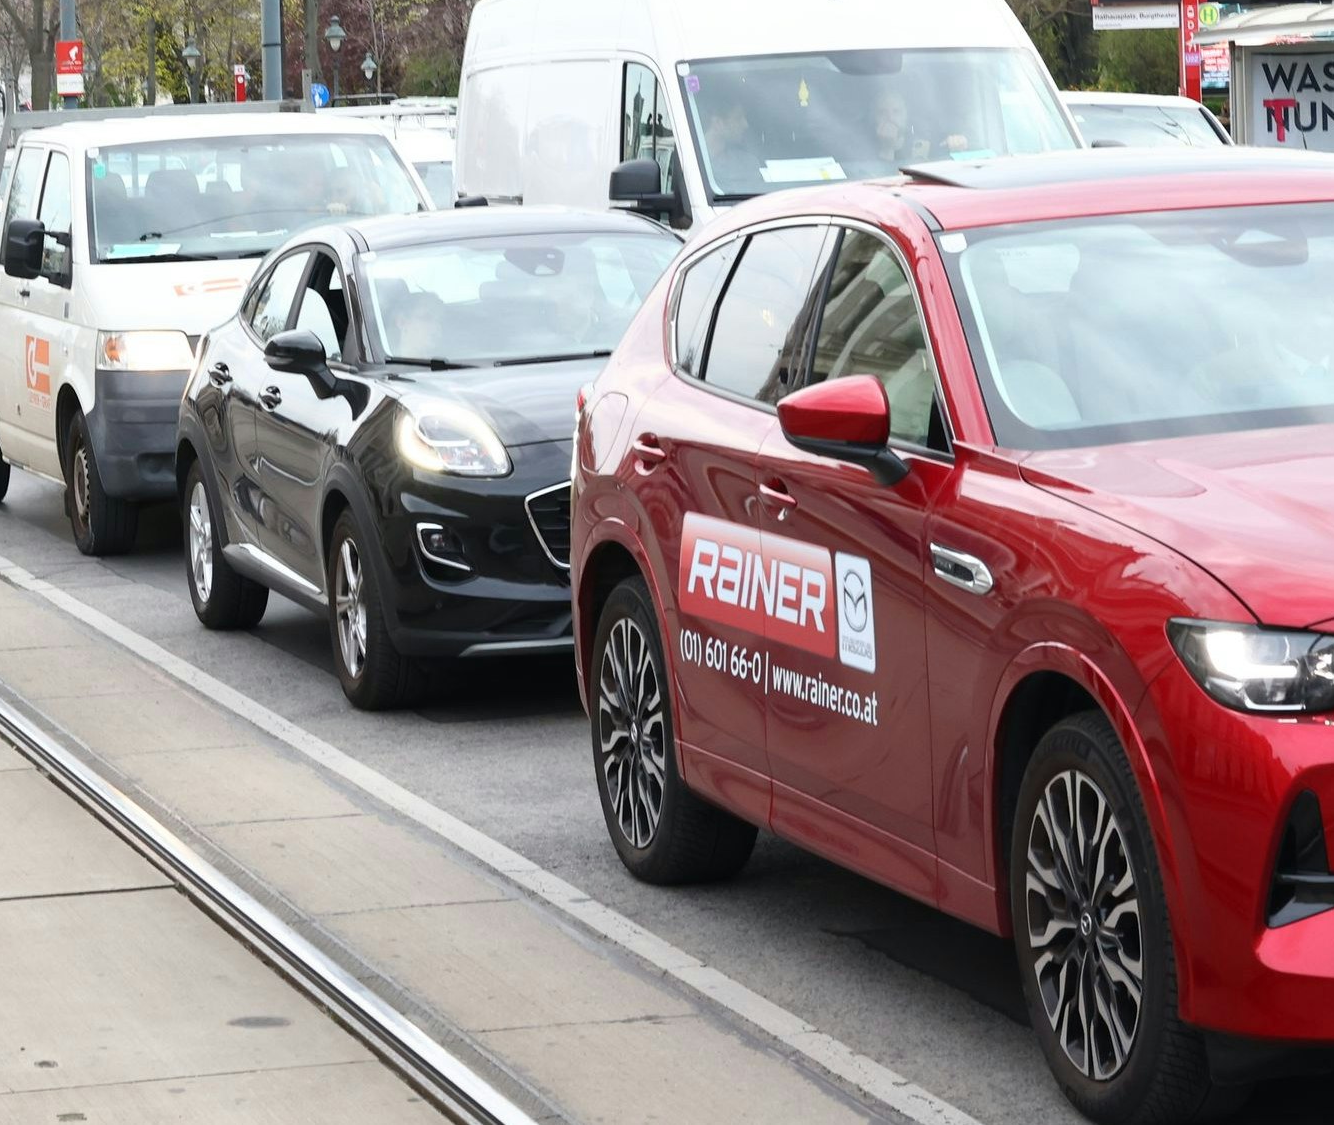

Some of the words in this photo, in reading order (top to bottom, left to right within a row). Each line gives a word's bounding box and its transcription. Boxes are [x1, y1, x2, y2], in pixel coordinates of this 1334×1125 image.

[679, 628, 702, 668] (01)
[705, 637, 728, 673] 601
[730, 646, 762, 684] 66-0
[772, 665, 878, 726] www.rainer.co.at
